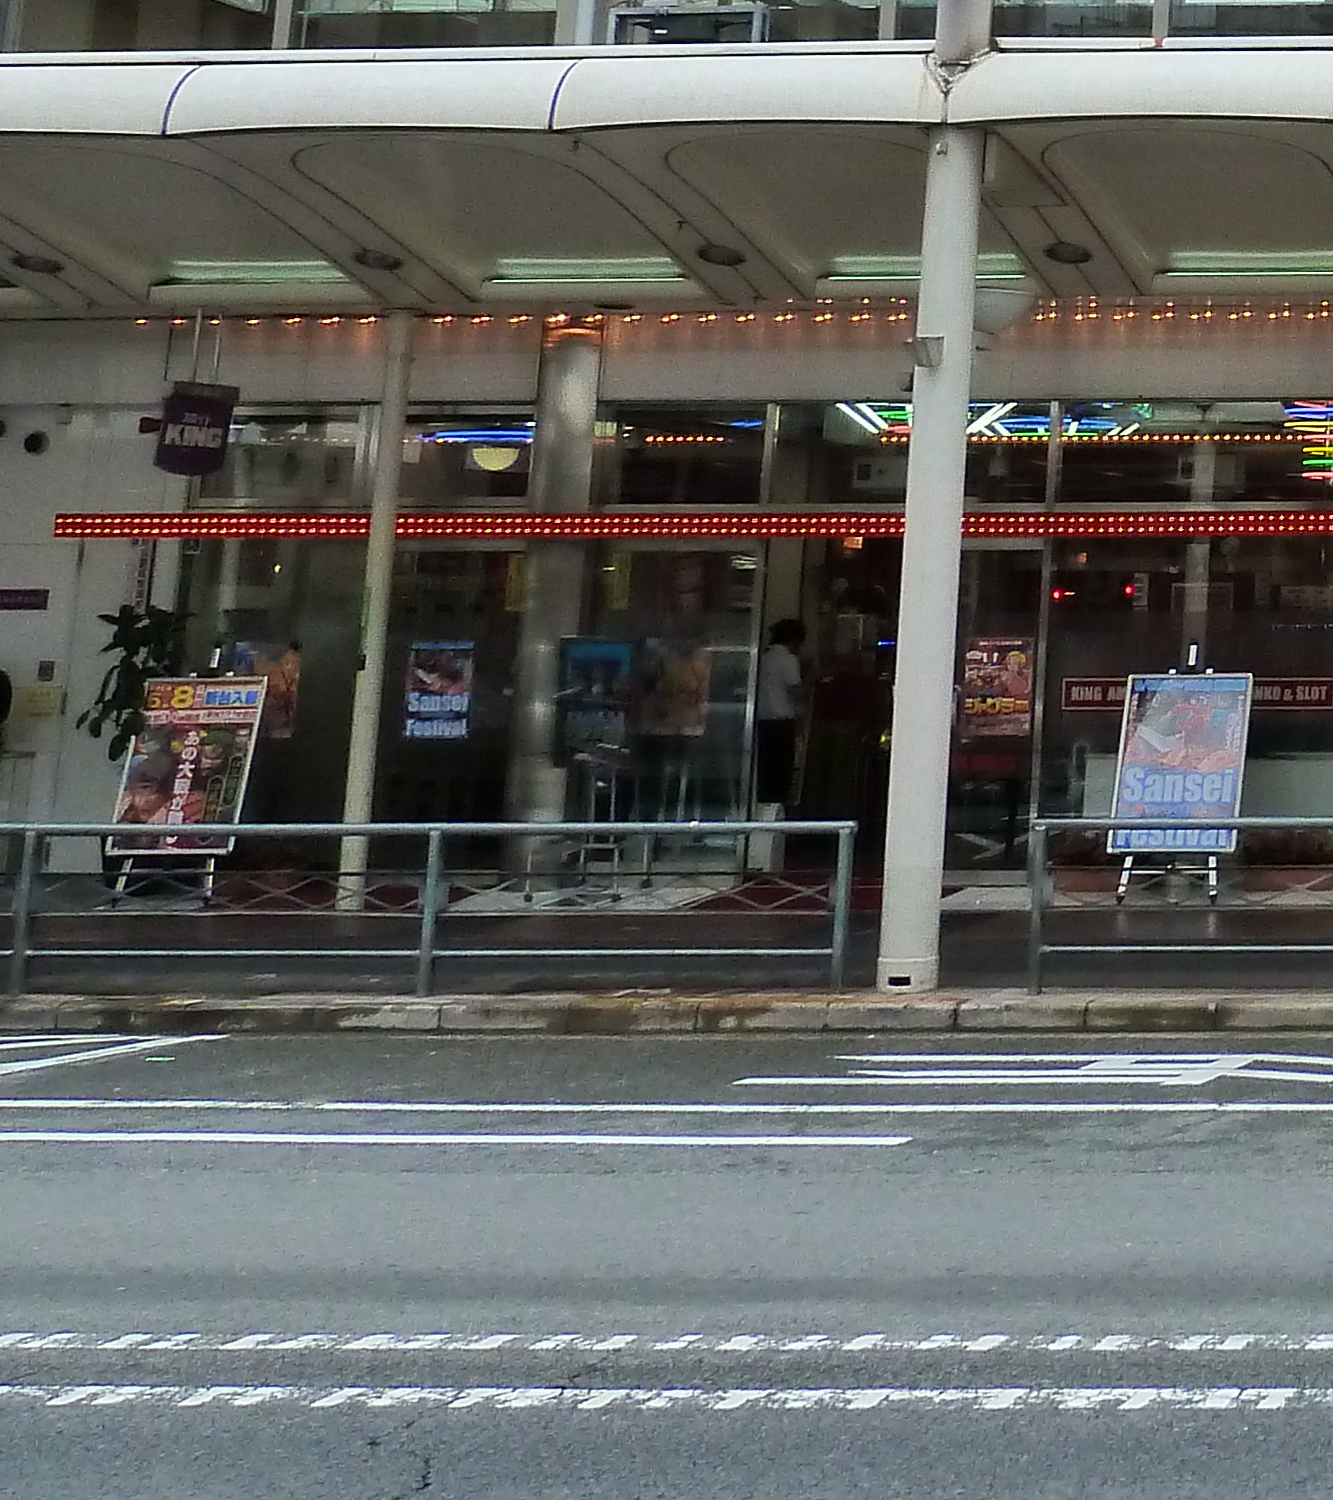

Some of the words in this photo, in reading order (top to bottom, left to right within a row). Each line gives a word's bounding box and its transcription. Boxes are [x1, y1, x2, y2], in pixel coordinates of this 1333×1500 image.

[165, 423, 223, 448] KING
[408, 692, 469, 712] Sansei
[1071, 686, 1103, 701] KING
[1296, 685, 1328, 701] SLOT
[1123, 765, 1234, 804] Sansei
